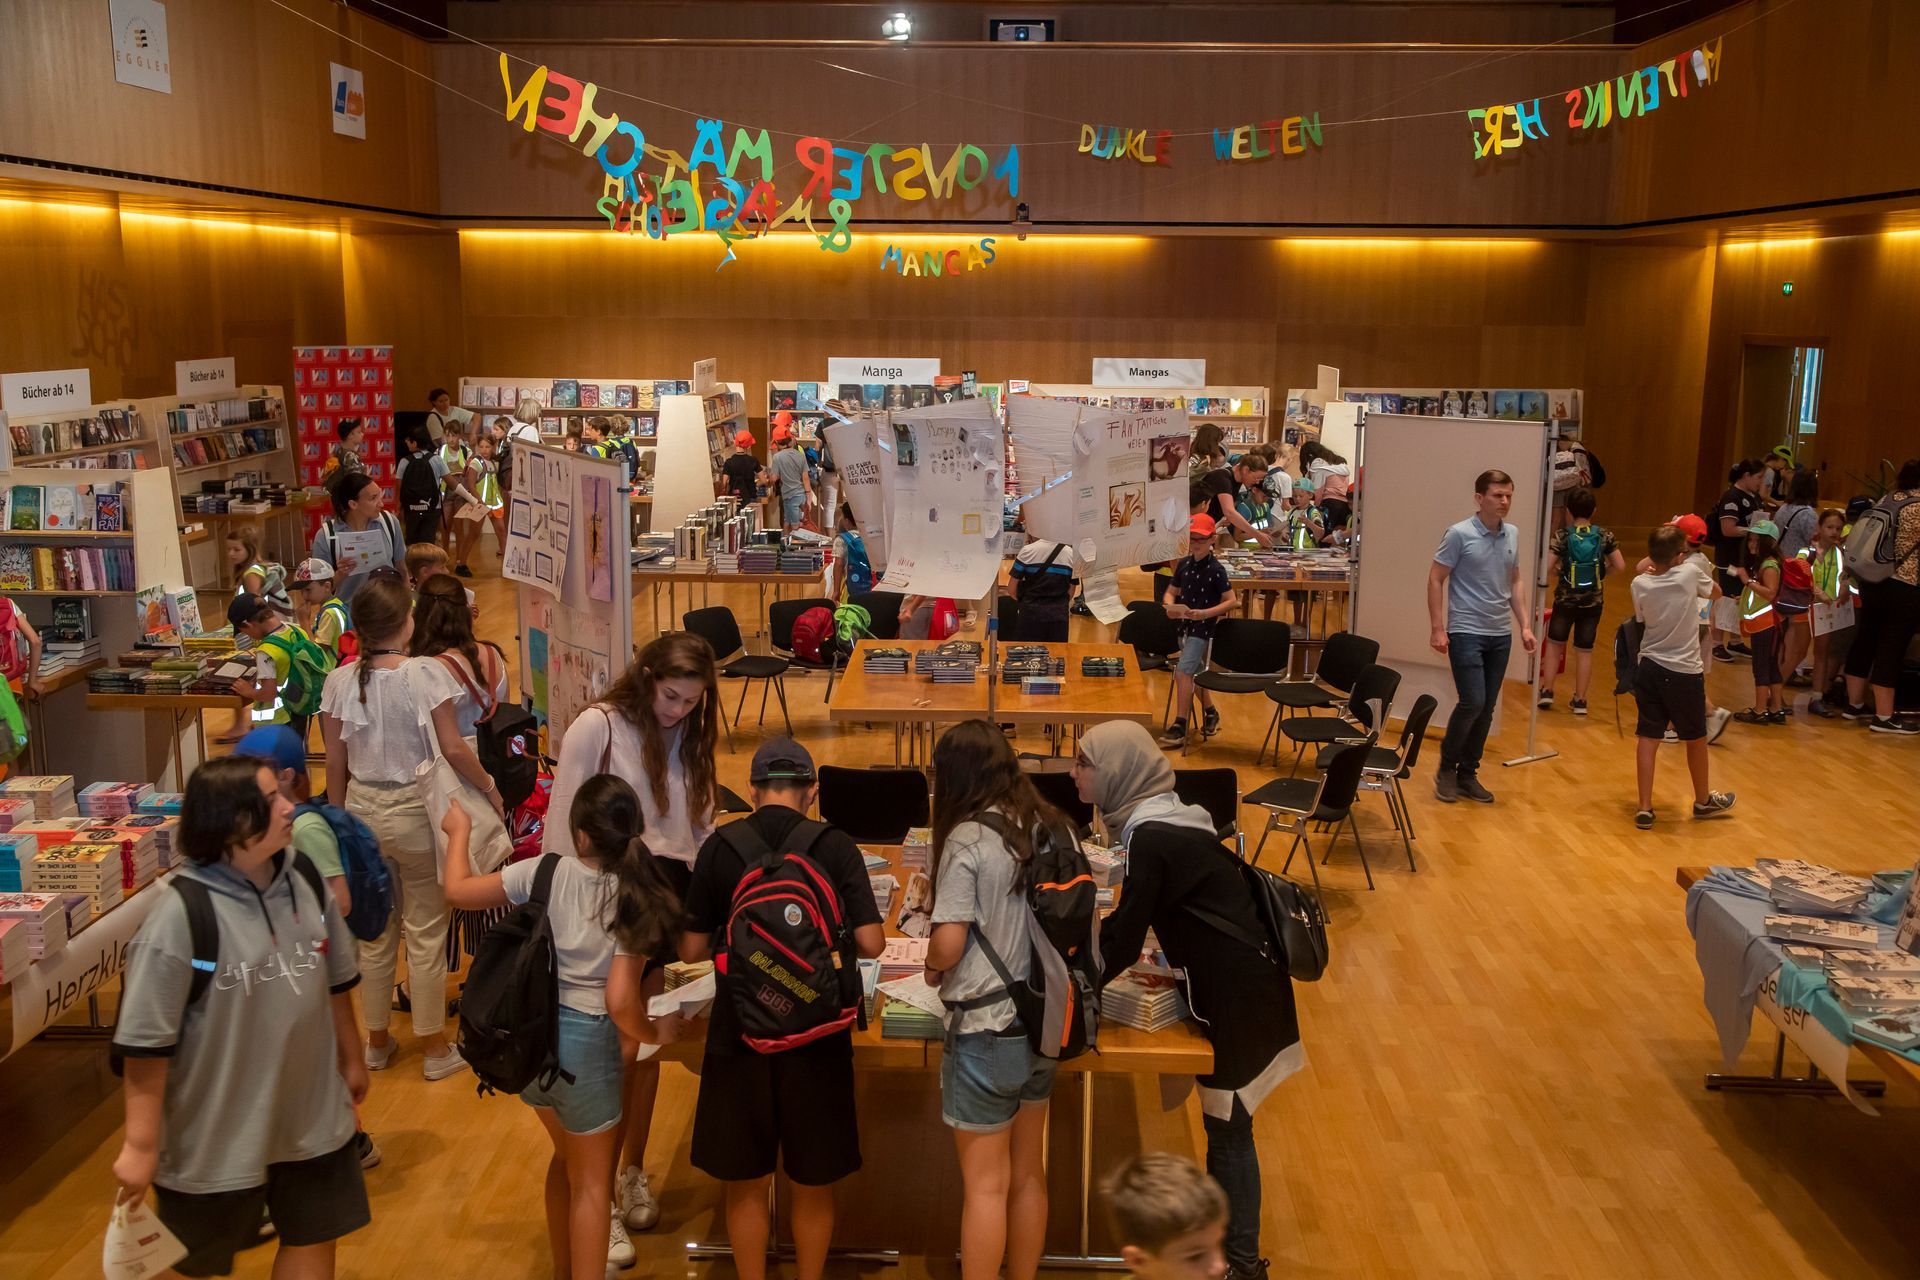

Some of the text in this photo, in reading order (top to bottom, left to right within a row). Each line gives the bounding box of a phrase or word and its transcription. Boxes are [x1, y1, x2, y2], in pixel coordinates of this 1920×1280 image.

[116, 50, 169, 74] EGGLER
[1078, 111, 1324, 169] DUNKLE WELTEN
[189, 369, 225, 383] Bücher ab 14
[312, 369, 328, 382] VN
[337, 369, 352, 381] VN
[361, 369, 377, 380] VN
[861, 365, 903, 380] Manga
[1128, 367, 1169, 379] Mangas
[22, 383, 75, 399] Bücher ab 14
[301, 394, 317, 407] VN
[326, 394, 341, 406] VN
[350, 393, 366, 406] VN
[374, 393, 390, 406] VN
[315, 418, 331, 431] VN
[363, 416, 379, 429] VN
[304, 443, 320, 455] VN
[377, 441, 392, 452] VN
[366, 464, 382, 475] VN
[756, 984, 795, 1017] 1905
